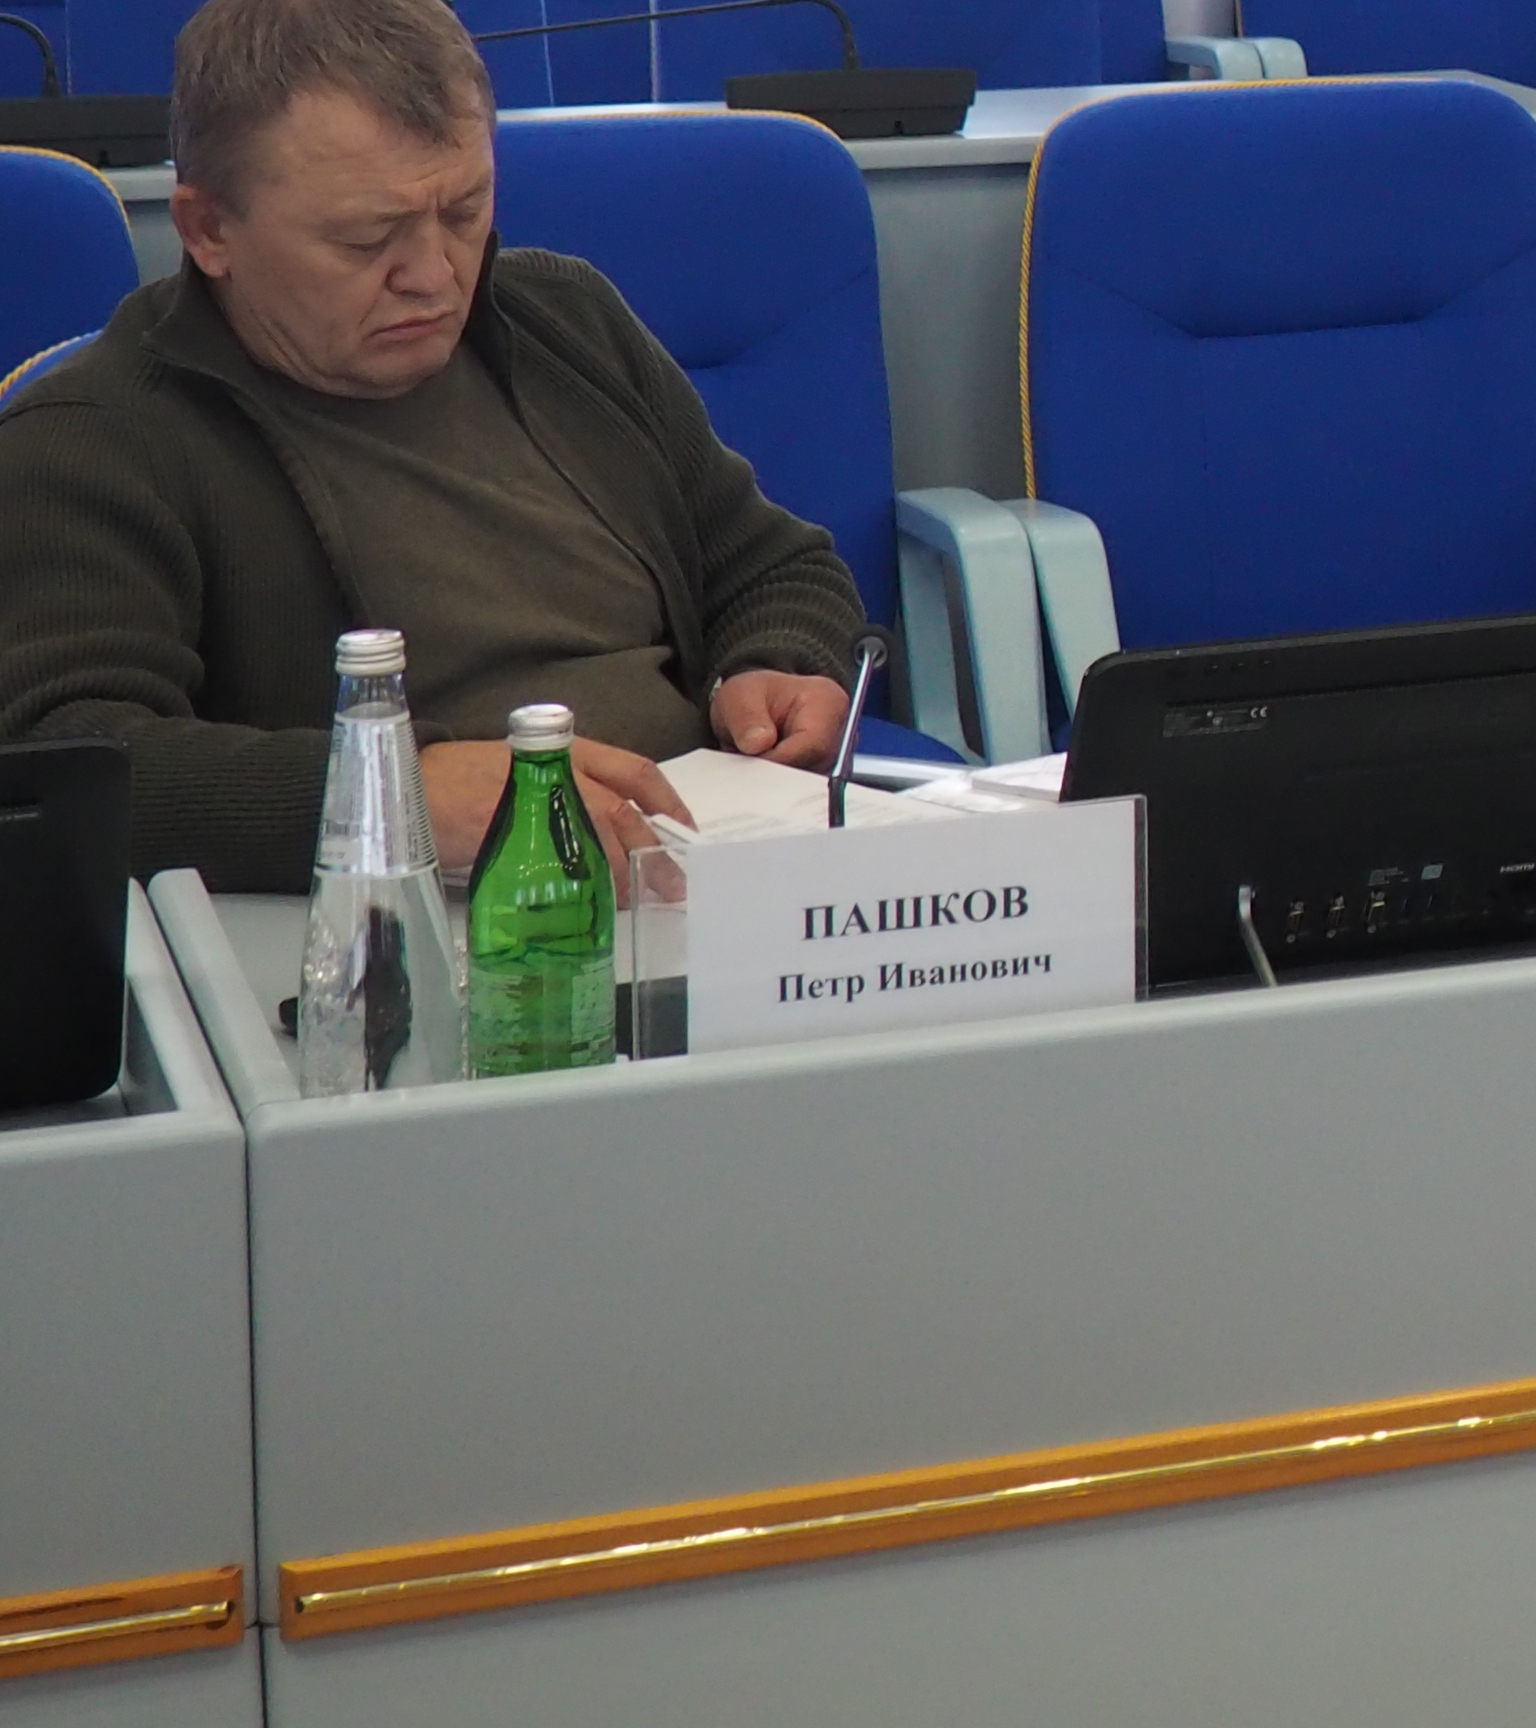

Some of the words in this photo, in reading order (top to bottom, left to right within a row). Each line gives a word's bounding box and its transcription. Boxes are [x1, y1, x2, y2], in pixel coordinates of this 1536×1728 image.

[802, 885, 1030, 940] ПАШКОВ
[778, 971, 865, 1002] Петр
[878, 953, 1052, 992] Иванович
